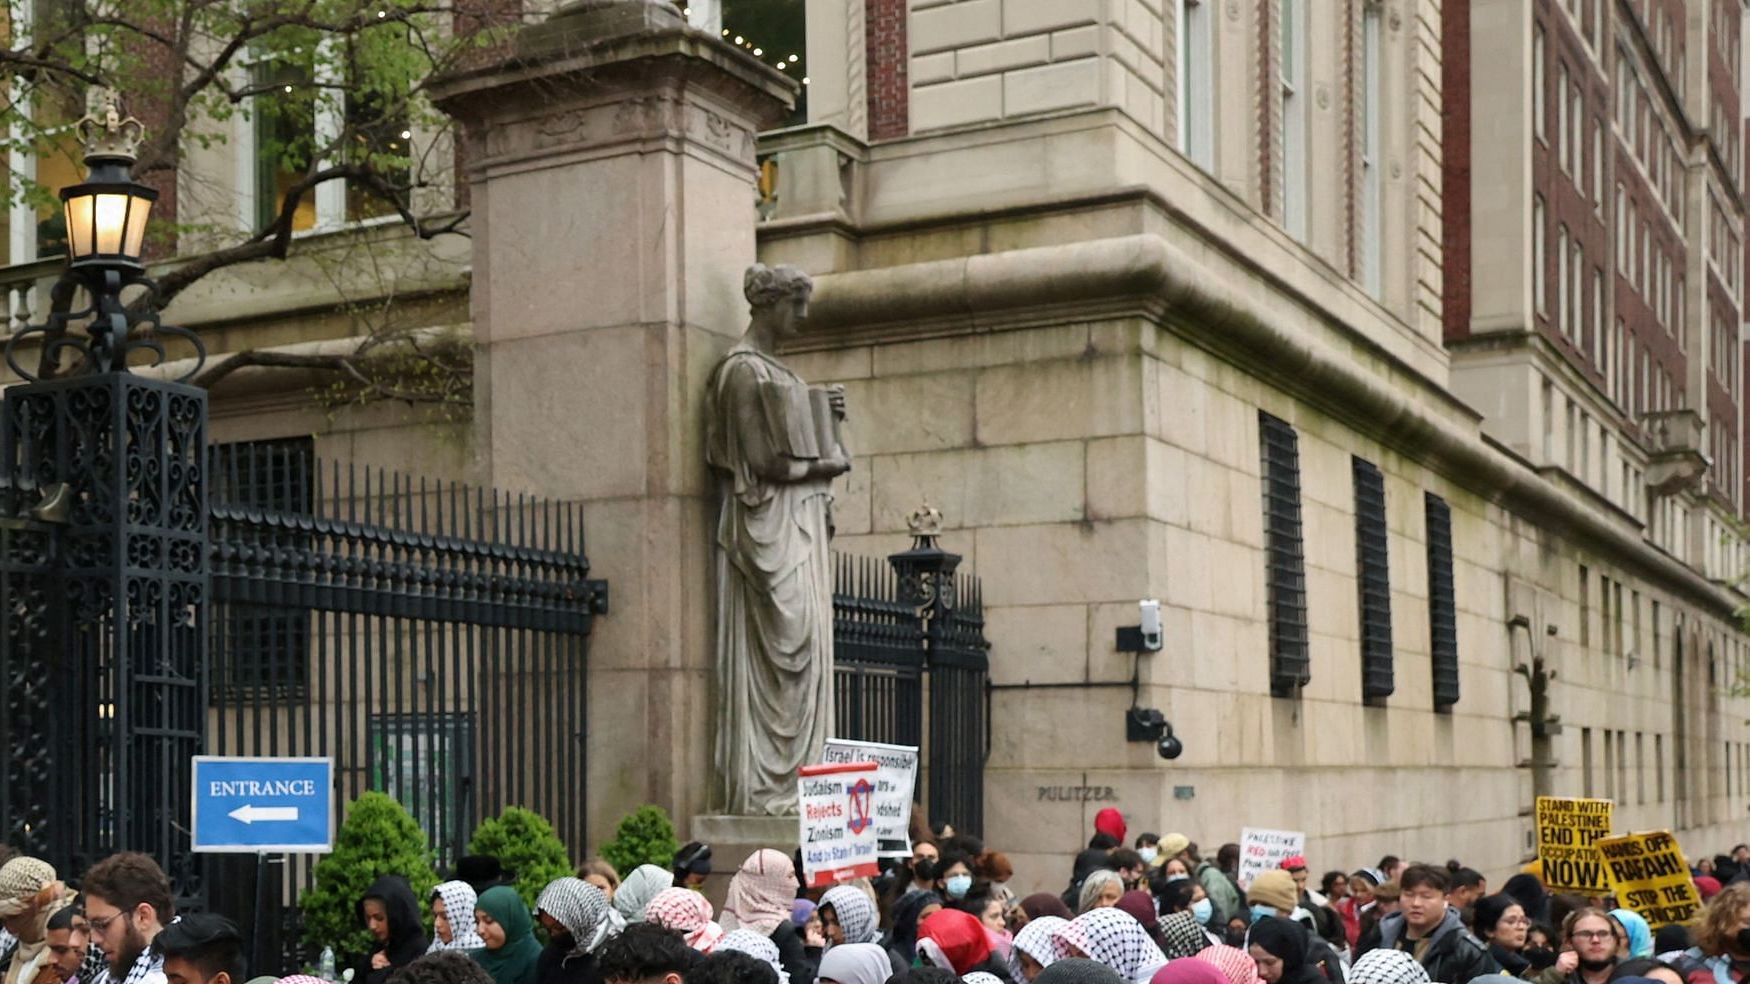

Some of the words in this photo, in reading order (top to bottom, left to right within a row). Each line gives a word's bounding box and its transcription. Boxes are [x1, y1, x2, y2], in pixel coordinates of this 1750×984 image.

[826, 748, 854, 763] Israel
[210, 779, 315, 796] ENTRANCE
[803, 779, 842, 797] Judaism
[1038, 787, 1118, 801] PULITZER
[806, 801, 842, 822] Rejects
[1539, 799, 1574, 812] STAND
[1577, 801, 1609, 813] WITH
[1540, 813, 1609, 829] PALESTINE!
[1541, 827, 1573, 846] END
[1577, 829, 1610, 846] THE
[1540, 847, 1601, 861] OCCUPATIO
[1601, 840, 1643, 859] HANDS
[1644, 835, 1671, 853] OFF
[1543, 859, 1608, 888] NOW!
[1609, 852, 1683, 883] RAFAH!
[1626, 890, 1659, 908] STOP
[1663, 884, 1691, 903] THE
